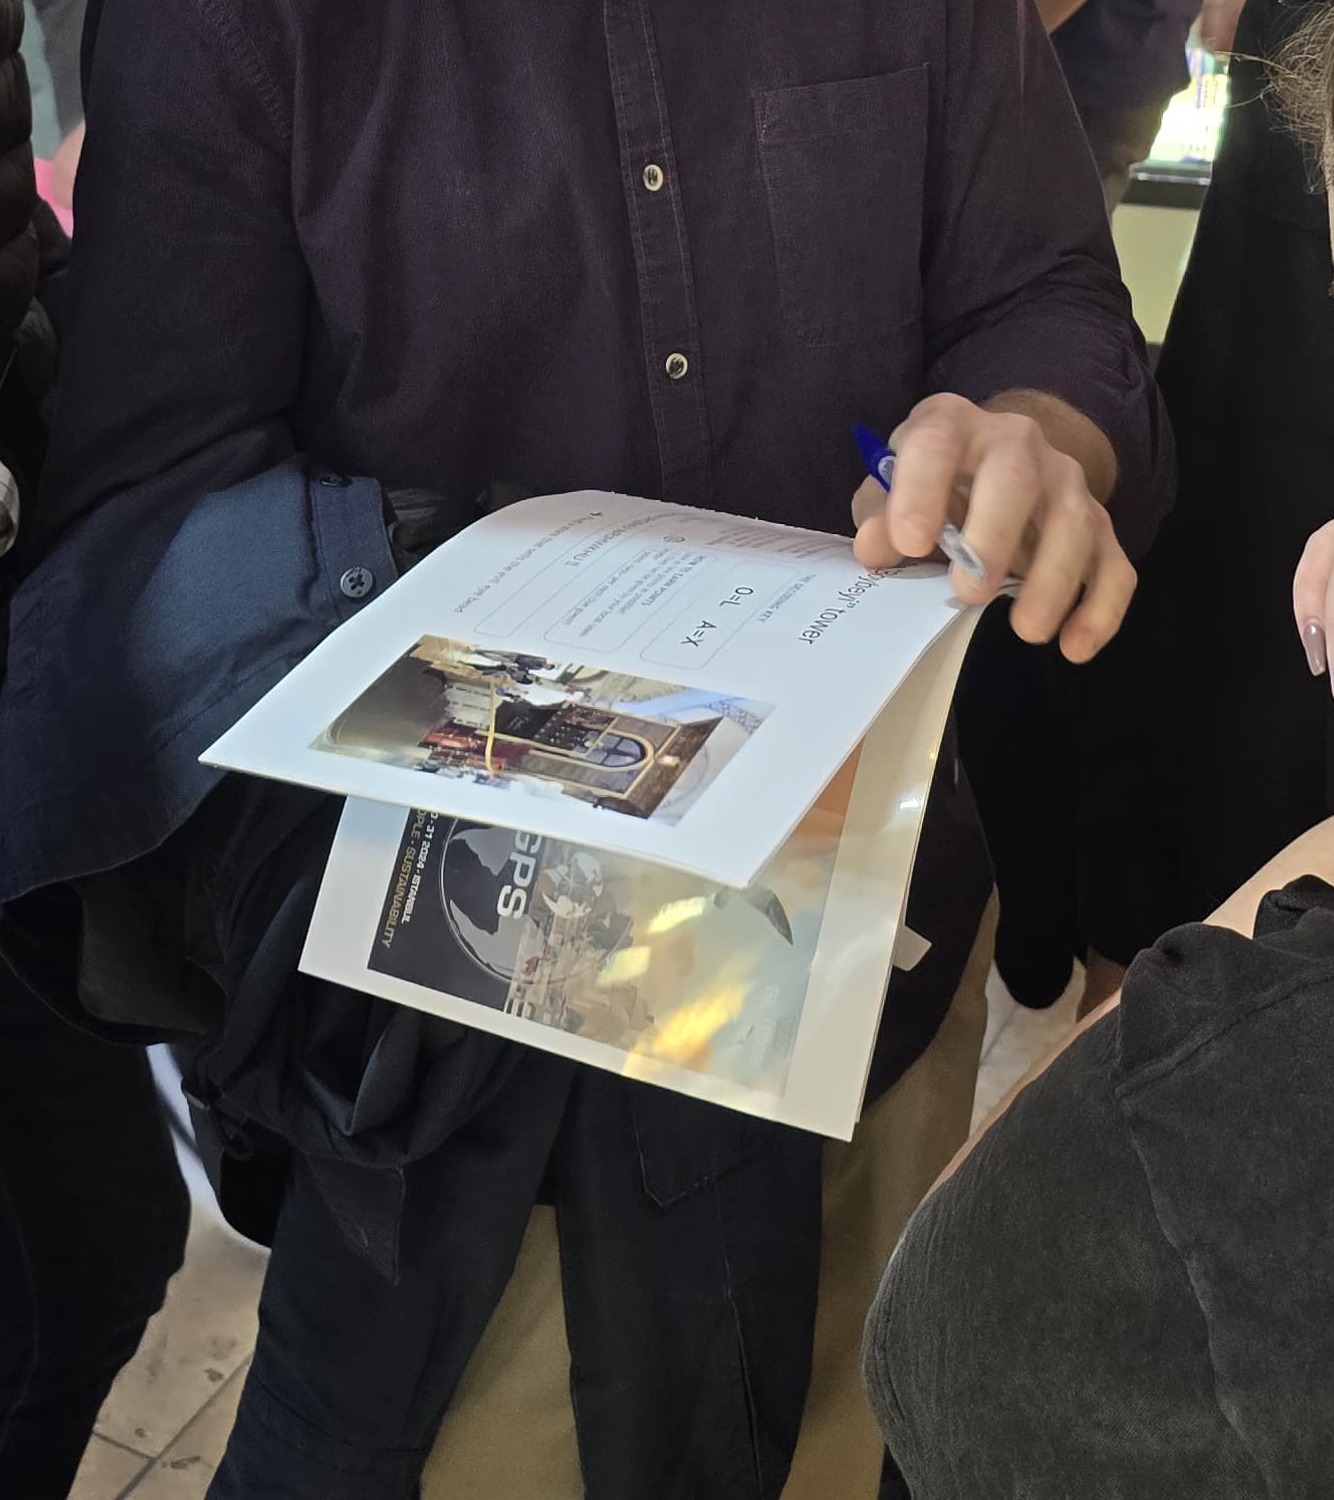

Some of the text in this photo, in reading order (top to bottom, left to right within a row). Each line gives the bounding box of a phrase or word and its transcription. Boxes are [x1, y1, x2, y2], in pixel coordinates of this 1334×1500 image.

[680, 586, 754, 647] O=L A=X
[798, 607, 845, 644] tower
[425, 825, 435, 839] 31
[416, 841, 431, 869] 2024
[382, 846, 416, 948] SUSTAINABILITY
[401, 874, 421, 925] ISTANBUL
